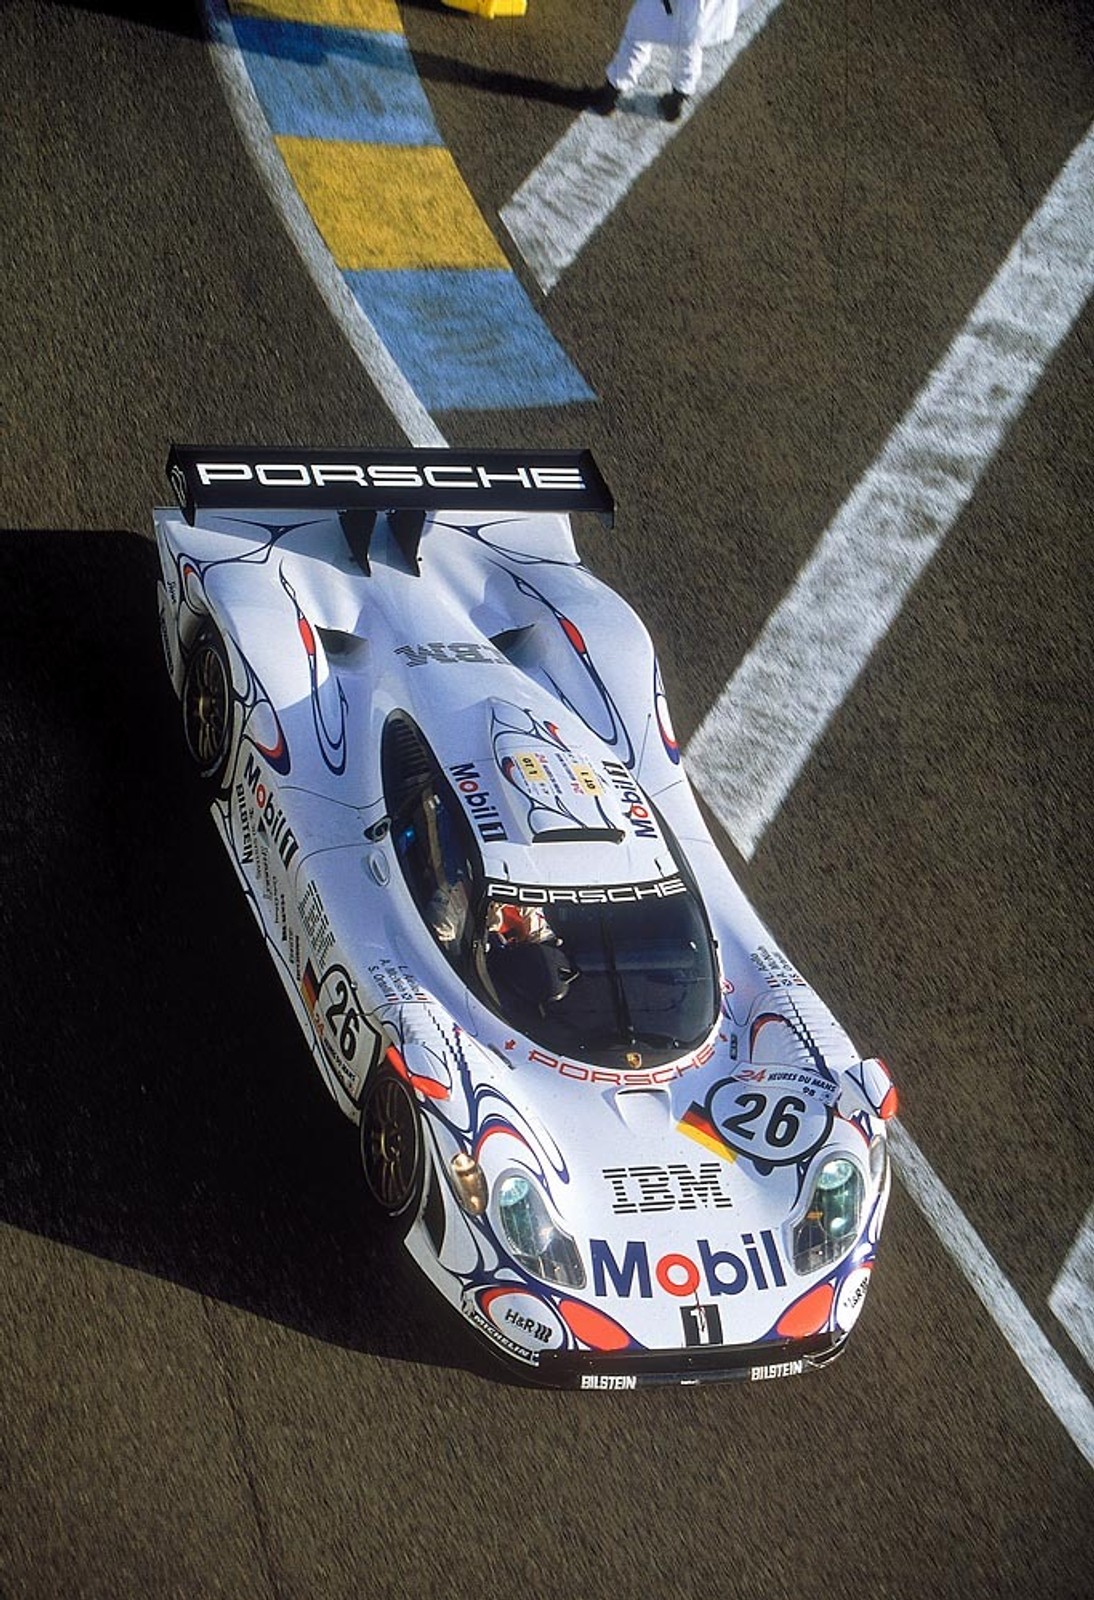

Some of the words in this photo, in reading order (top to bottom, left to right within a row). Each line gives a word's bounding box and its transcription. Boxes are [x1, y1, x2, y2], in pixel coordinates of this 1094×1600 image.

[195, 463, 586, 491] PORSCHE
[522, 757, 534, 768] GT
[244, 752, 287, 844] Mobil
[449, 762, 499, 820] Mobil
[612, 779, 658, 838] Mobil
[487, 879, 686, 904] PORSCHE
[298, 880, 336, 971] IBM
[325, 980, 360, 1061] 26
[528, 1044, 717, 1085] PORSCHE
[735, 1068, 767, 1083] 24
[767, 1072, 797, 1082] HEURES
[798, 1074, 812, 1084] DU
[811, 1079, 837, 1093] MANS
[722, 1093, 806, 1147] 26
[602, 1162, 734, 1215] IBM
[589, 1230, 787, 1298] Mobil
[474, 1314, 531, 1357] MICHELIN
[505, 1308, 535, 1333] H&R
[580, 1375, 638, 1390] BILSTEIN
[751, 1360, 803, 1381] BILSTEIN
